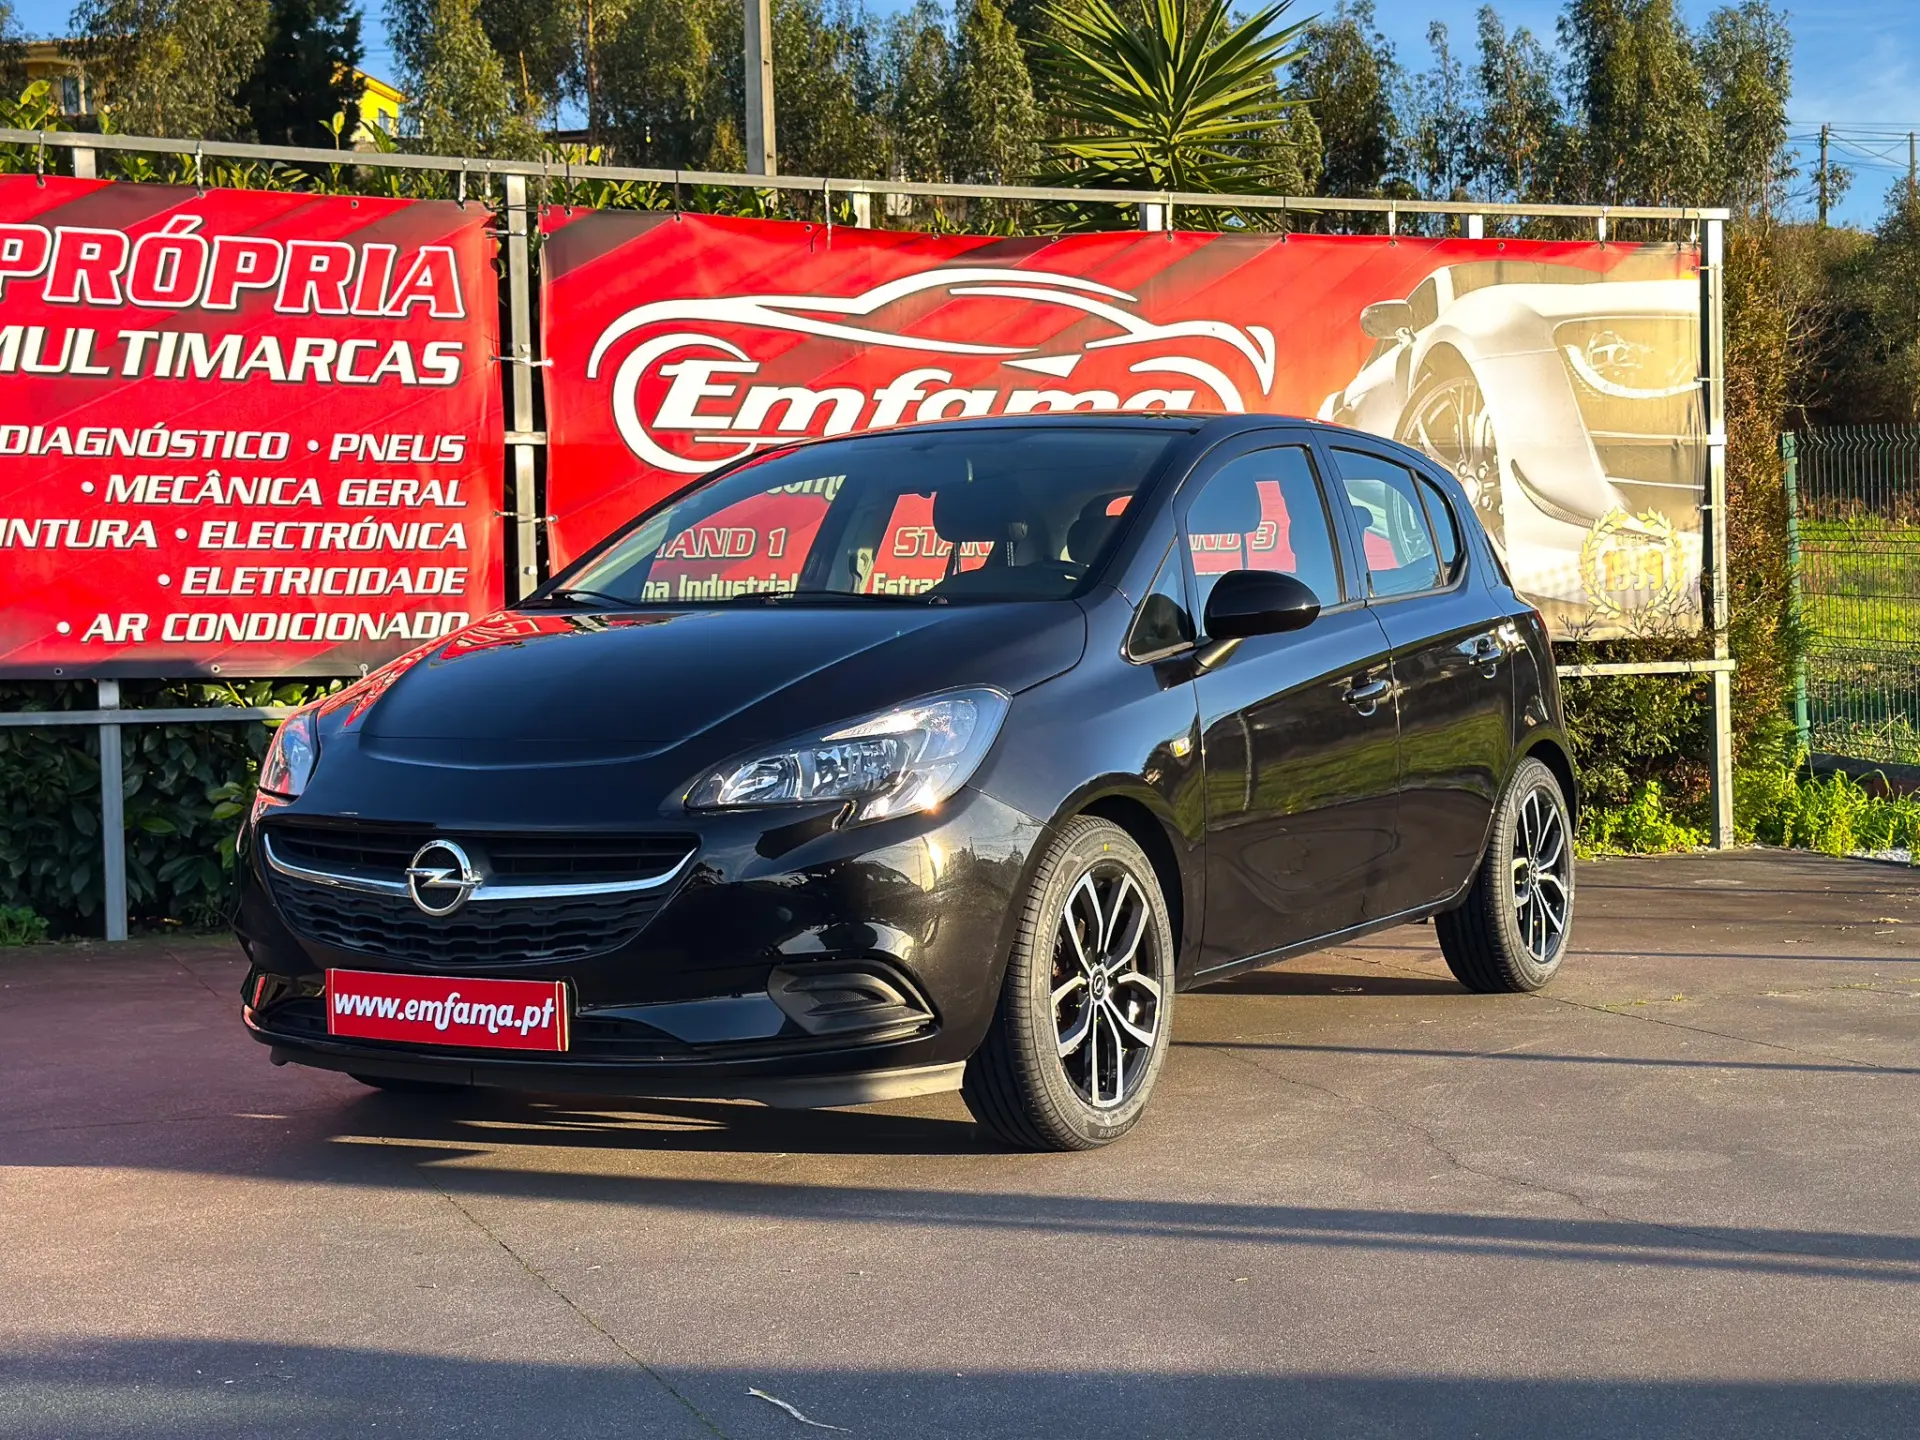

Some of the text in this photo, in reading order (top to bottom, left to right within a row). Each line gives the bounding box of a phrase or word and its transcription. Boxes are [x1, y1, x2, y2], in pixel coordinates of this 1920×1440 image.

[0, 215, 466, 319] PRÓPRIA
[0, 422, 467, 462] DIAGNÓSTICO PNEUS
[104, 469, 468, 507] MECÂNICA GERAL
[198, 515, 468, 550] ELECTRÓNICA
[656, 527, 786, 558] AND 1
[1252, 521, 1277, 549] 3
[181, 566, 468, 596] ELETRICIDADE
[679, 573, 799, 602] Industrial
[1603, 549, 1664, 592] 1999
[81, 611, 470, 642] AR CONDICIONADO
[334, 992, 555, 1036] www.emfama.pt
